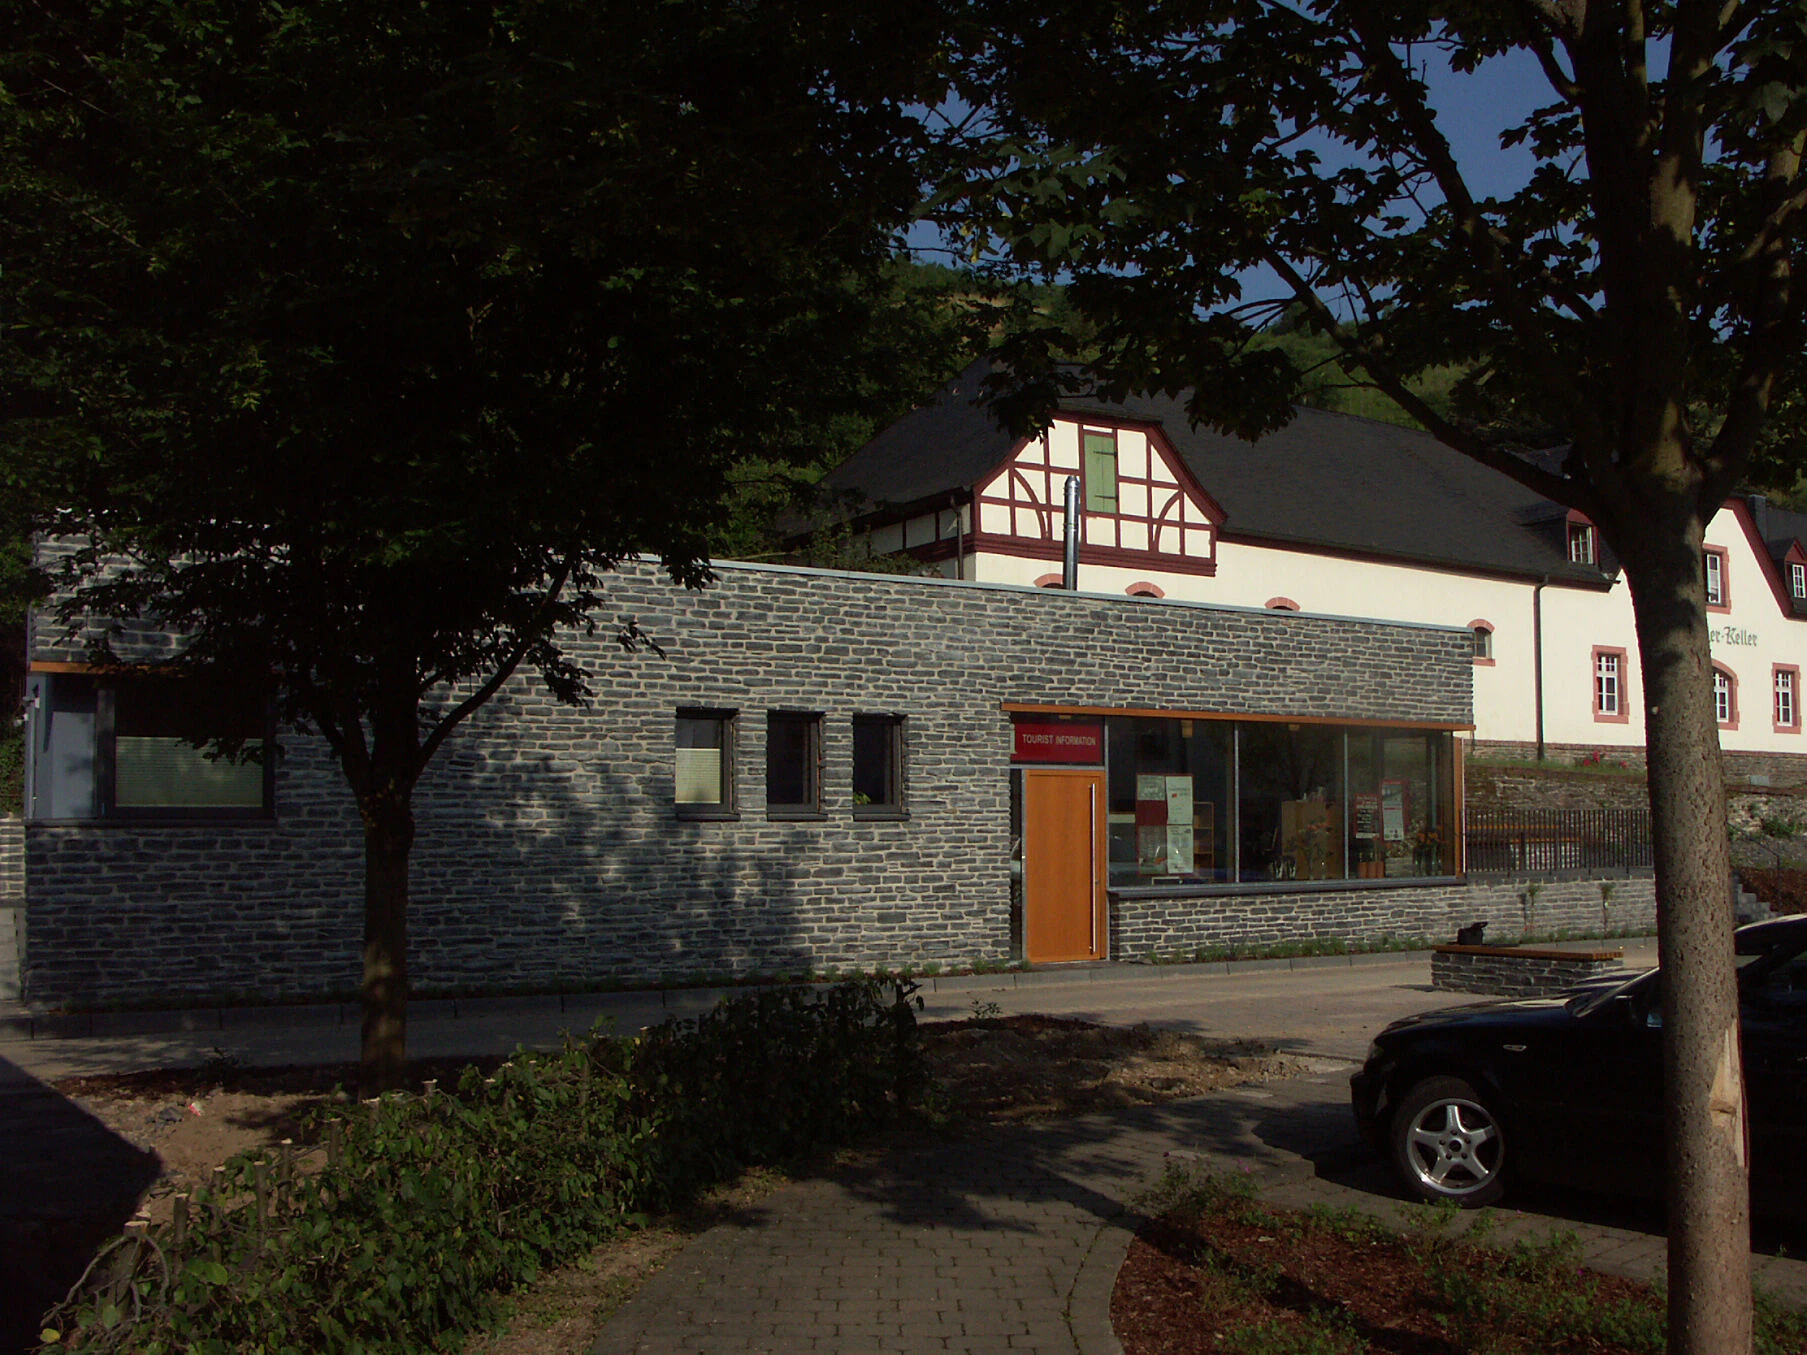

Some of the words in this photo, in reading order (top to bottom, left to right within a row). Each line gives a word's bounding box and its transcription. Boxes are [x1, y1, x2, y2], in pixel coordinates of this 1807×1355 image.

[1710, 626, 1757, 646] er-Keller
[1022, 734, 1054, 745] TOURIST
[1055, 735, 1097, 746] INFORMATION
